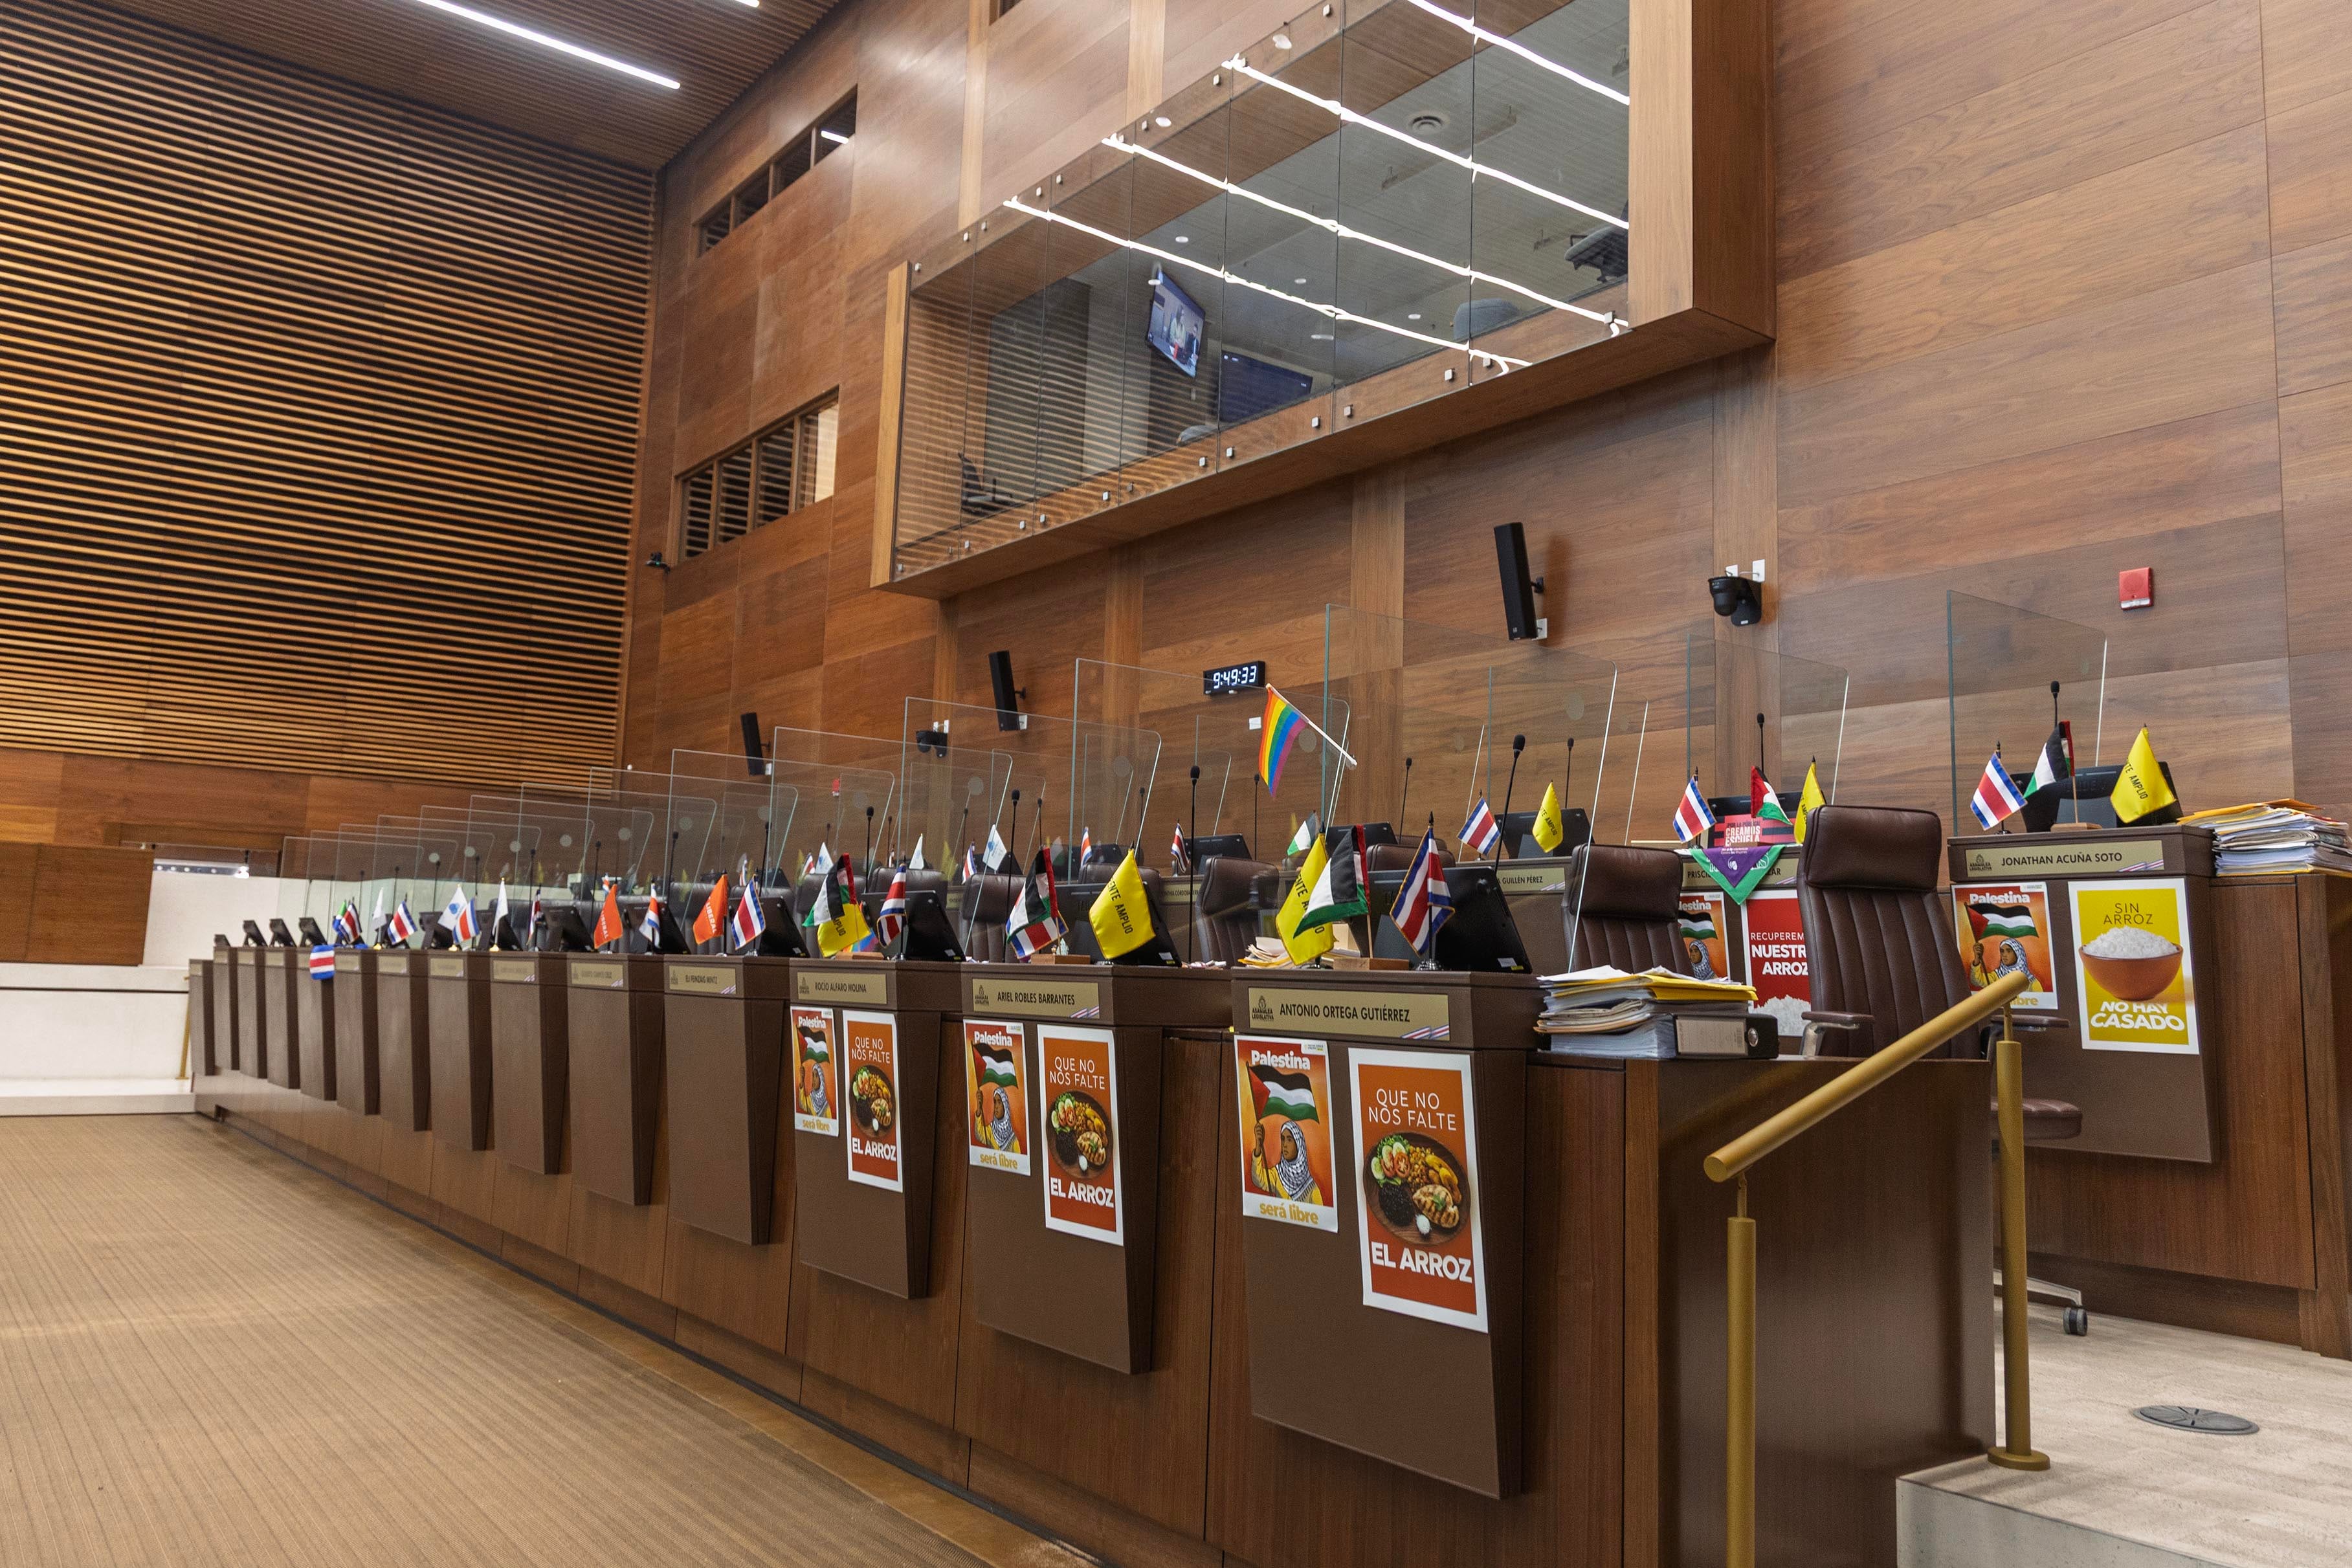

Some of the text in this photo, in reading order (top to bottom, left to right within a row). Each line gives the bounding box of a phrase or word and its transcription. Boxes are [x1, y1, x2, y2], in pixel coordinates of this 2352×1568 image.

[1213, 665, 1257, 689] 9:49:33
[2129, 775, 2148, 799] AMPLIO
[1725, 826, 1760, 836] CREAMOS
[2001, 852, 2122, 866] JONATHAN ACUÑA SOTO
[1295, 874, 1308, 897] ENTE
[1502, 876, 1525, 884] GUILLÉN
[1527, 875, 1543, 883] PÉREZ
[1107, 878, 1134, 934] ENTE AMPLIO
[1678, 900, 1711, 911] lestina
[1969, 891, 2030, 905] Palestina
[2114, 903, 2139, 914] SIN
[2103, 914, 2153, 925] ARROZ
[1751, 932, 1804, 940] RECUPEREM
[1751, 944, 1806, 958] NUESTR
[1762, 962, 1808, 976] ARROZ
[815, 980, 829, 991] ROCÍO
[830, 983, 847, 993] ALFARO
[848, 984, 867, 993] MOLINA
[997, 991, 1014, 1002] ARIEL
[1015, 993, 1036, 1003] ROBLES
[1038, 994, 1075, 1005] BARRANTES
[1280, 1004, 1410, 1022] ANTONIO ORTEGA GUTIÉRREZ
[2100, 1001, 2169, 1015] NO HAY
[798, 1015, 826, 1030] Palestina
[2090, 1014, 2184, 1031] CASADO
[855, 1035, 883, 1051] QUE NO
[973, 1031, 1012, 1048] Palestina
[852, 1048, 891, 1065] NOS FALTE
[1054, 1055, 1095, 1074] QUE NO
[1251, 1050, 1311, 1070] Palestina
[1050, 1070, 1105, 1090] NOS FALTE
[1376, 1088, 1440, 1110] QUE NO
[1369, 1107, 1457, 1131] NOS FALTE
[852, 1137, 896, 1162] EL ARROZ
[980, 1151, 1018, 1170] será libre
[1050, 1177, 1115, 1209] EL ARROZ
[1259, 1203, 1319, 1225] será libre
[1371, 1241, 1472, 1284] EL ARROZ
